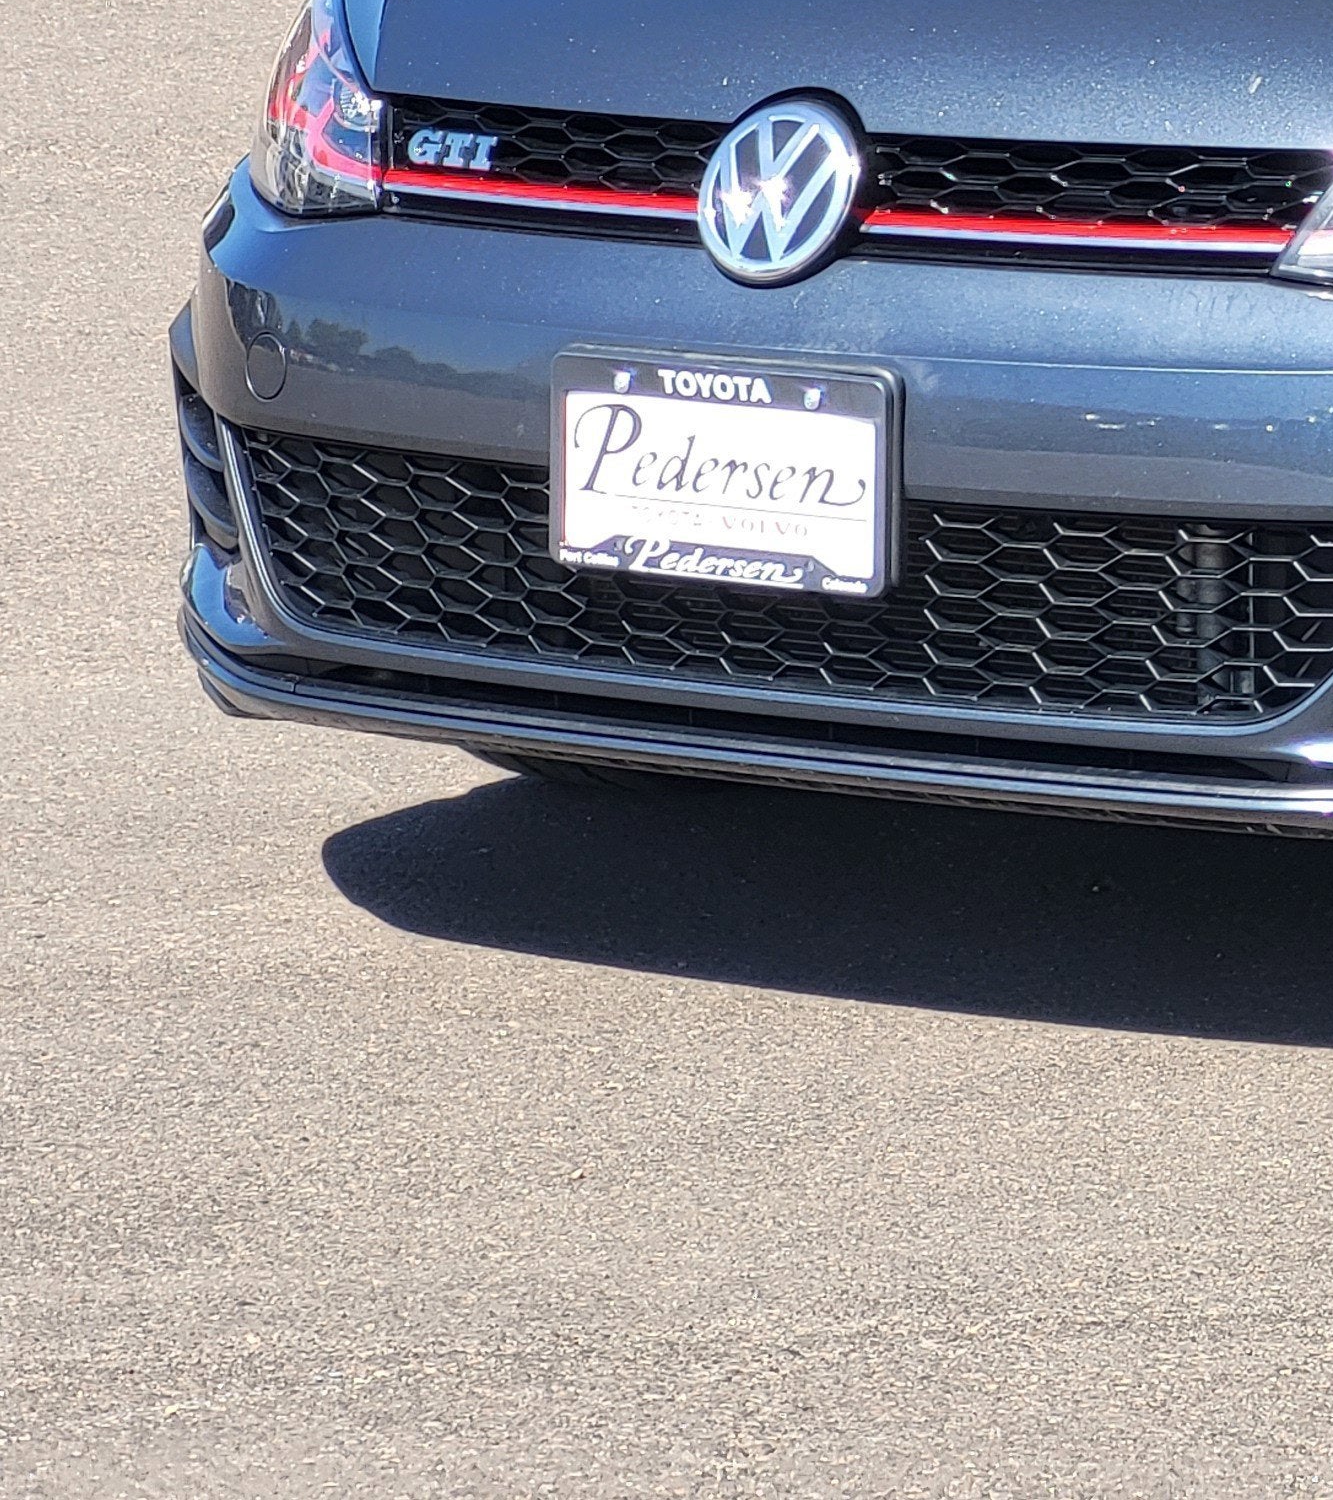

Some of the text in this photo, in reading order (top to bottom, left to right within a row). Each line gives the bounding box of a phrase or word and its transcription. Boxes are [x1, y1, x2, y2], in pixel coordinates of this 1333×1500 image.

[408, 129, 498, 172] GTI
[658, 368, 772, 404] TOYOTA
[573, 403, 867, 507] Pedersen
[624, 534, 804, 583] Pedersen
